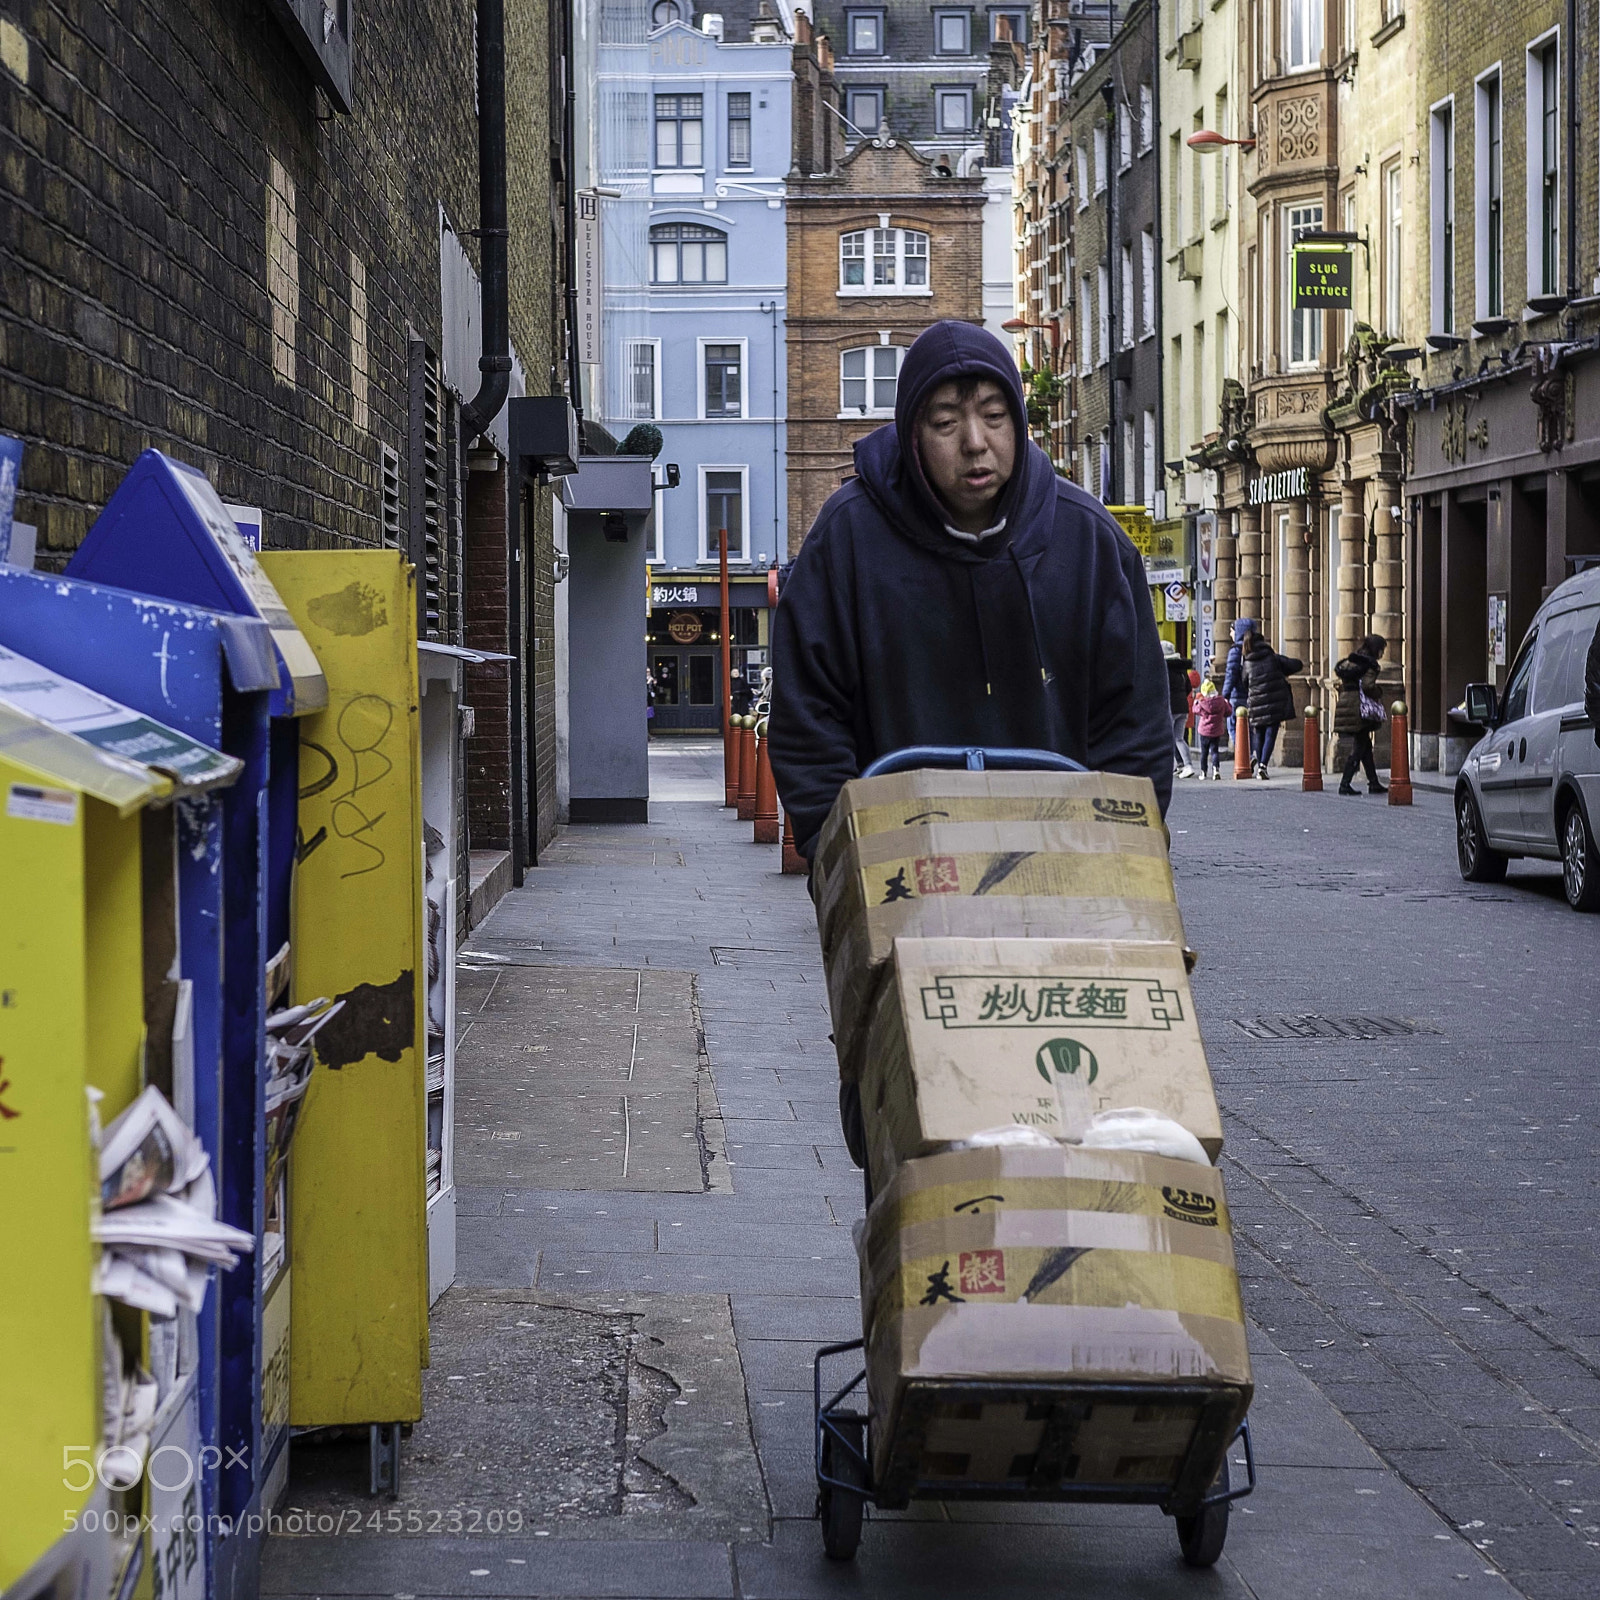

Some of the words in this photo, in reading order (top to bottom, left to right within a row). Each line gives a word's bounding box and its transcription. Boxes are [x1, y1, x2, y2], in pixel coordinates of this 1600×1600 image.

[1309, 263, 1338, 274] SLUG
[1320, 275, 1327, 285] &
[1298, 286, 1348, 297] LETTUCE
[686, 624, 703, 632] POT
